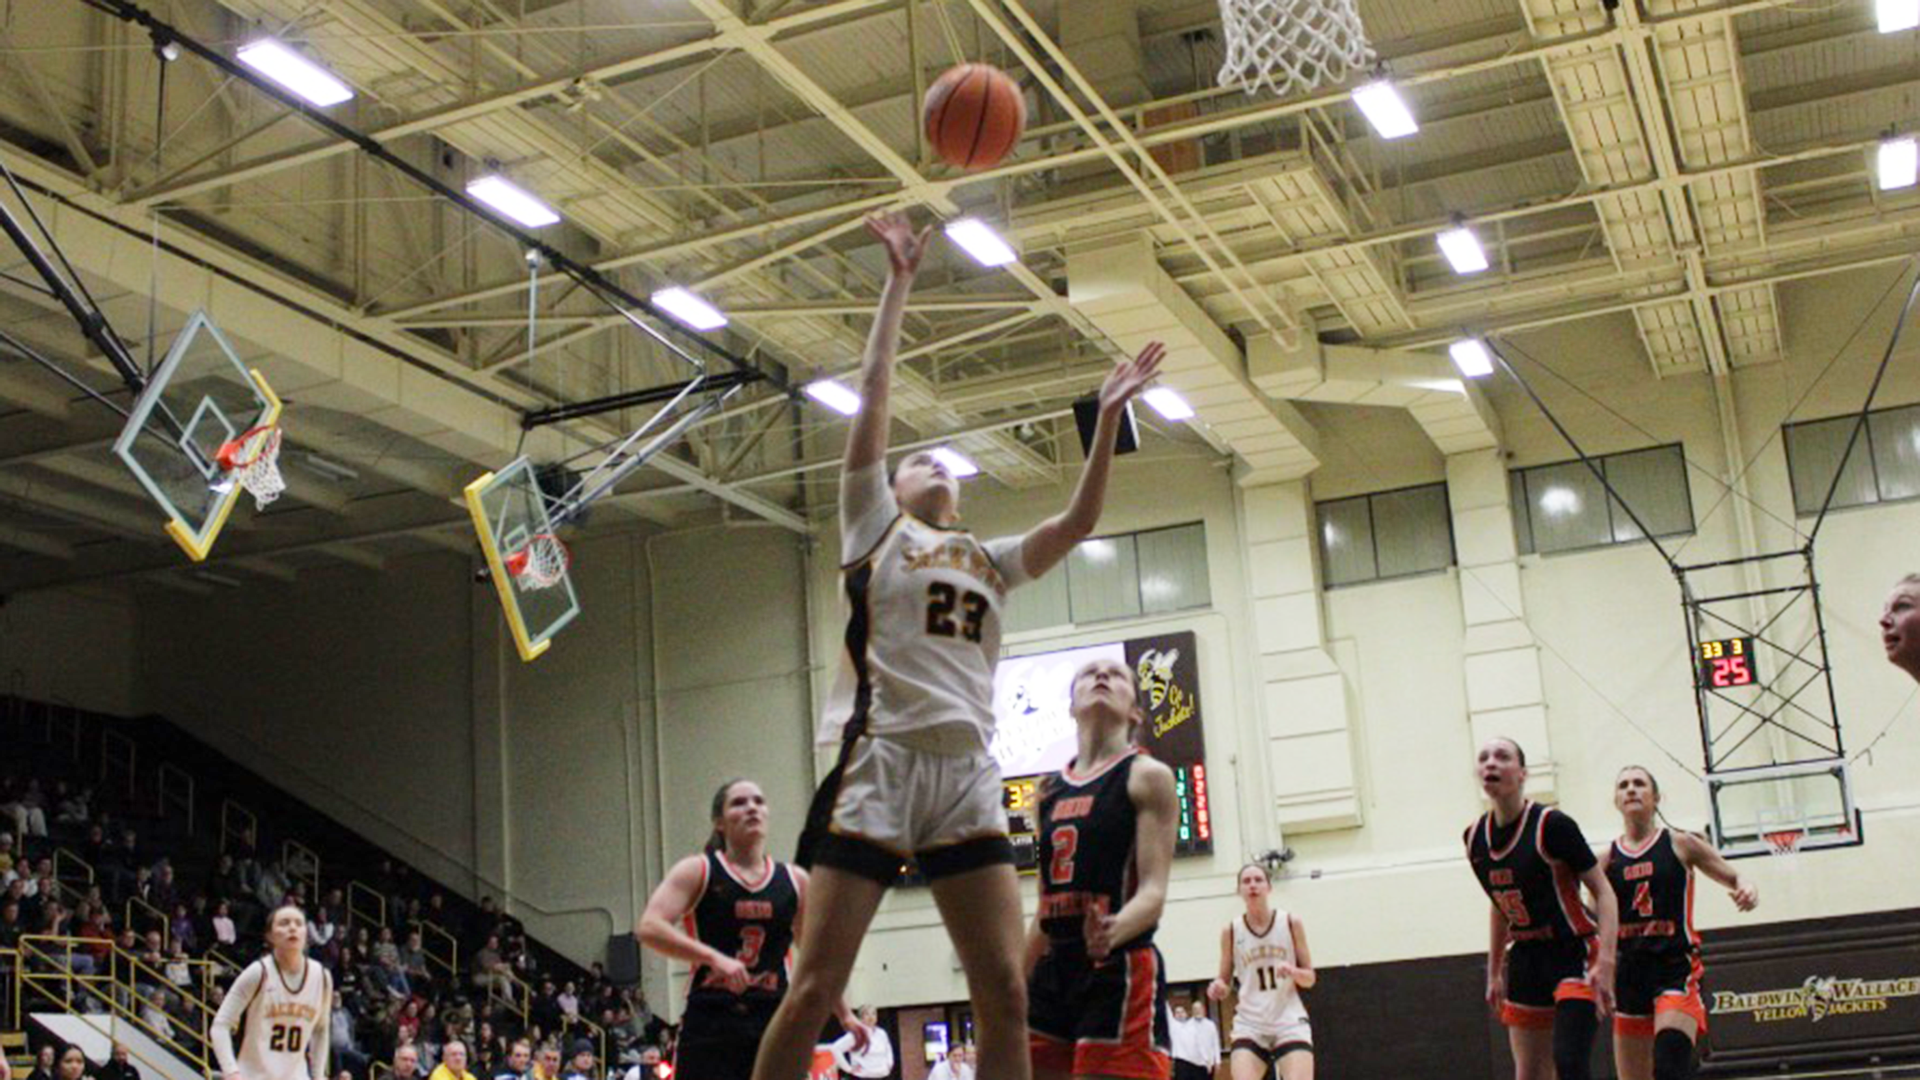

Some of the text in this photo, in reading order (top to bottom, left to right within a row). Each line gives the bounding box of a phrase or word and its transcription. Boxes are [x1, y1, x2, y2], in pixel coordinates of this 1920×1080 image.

[926, 580, 991, 643] 23
[1701, 638, 1743, 659] 33 3
[1712, 656, 1751, 686] 25
[1050, 824, 1079, 884] 2
[1632, 881, 1654, 917] 4
[736, 925, 767, 968] 3
[1257, 965, 1278, 992] 11
[1711, 977, 1920, 1014] BALDWIN WALLACE
[1753, 1000, 1888, 1022] YELLOW JACKETS
[270, 1023, 303, 1052] 20
